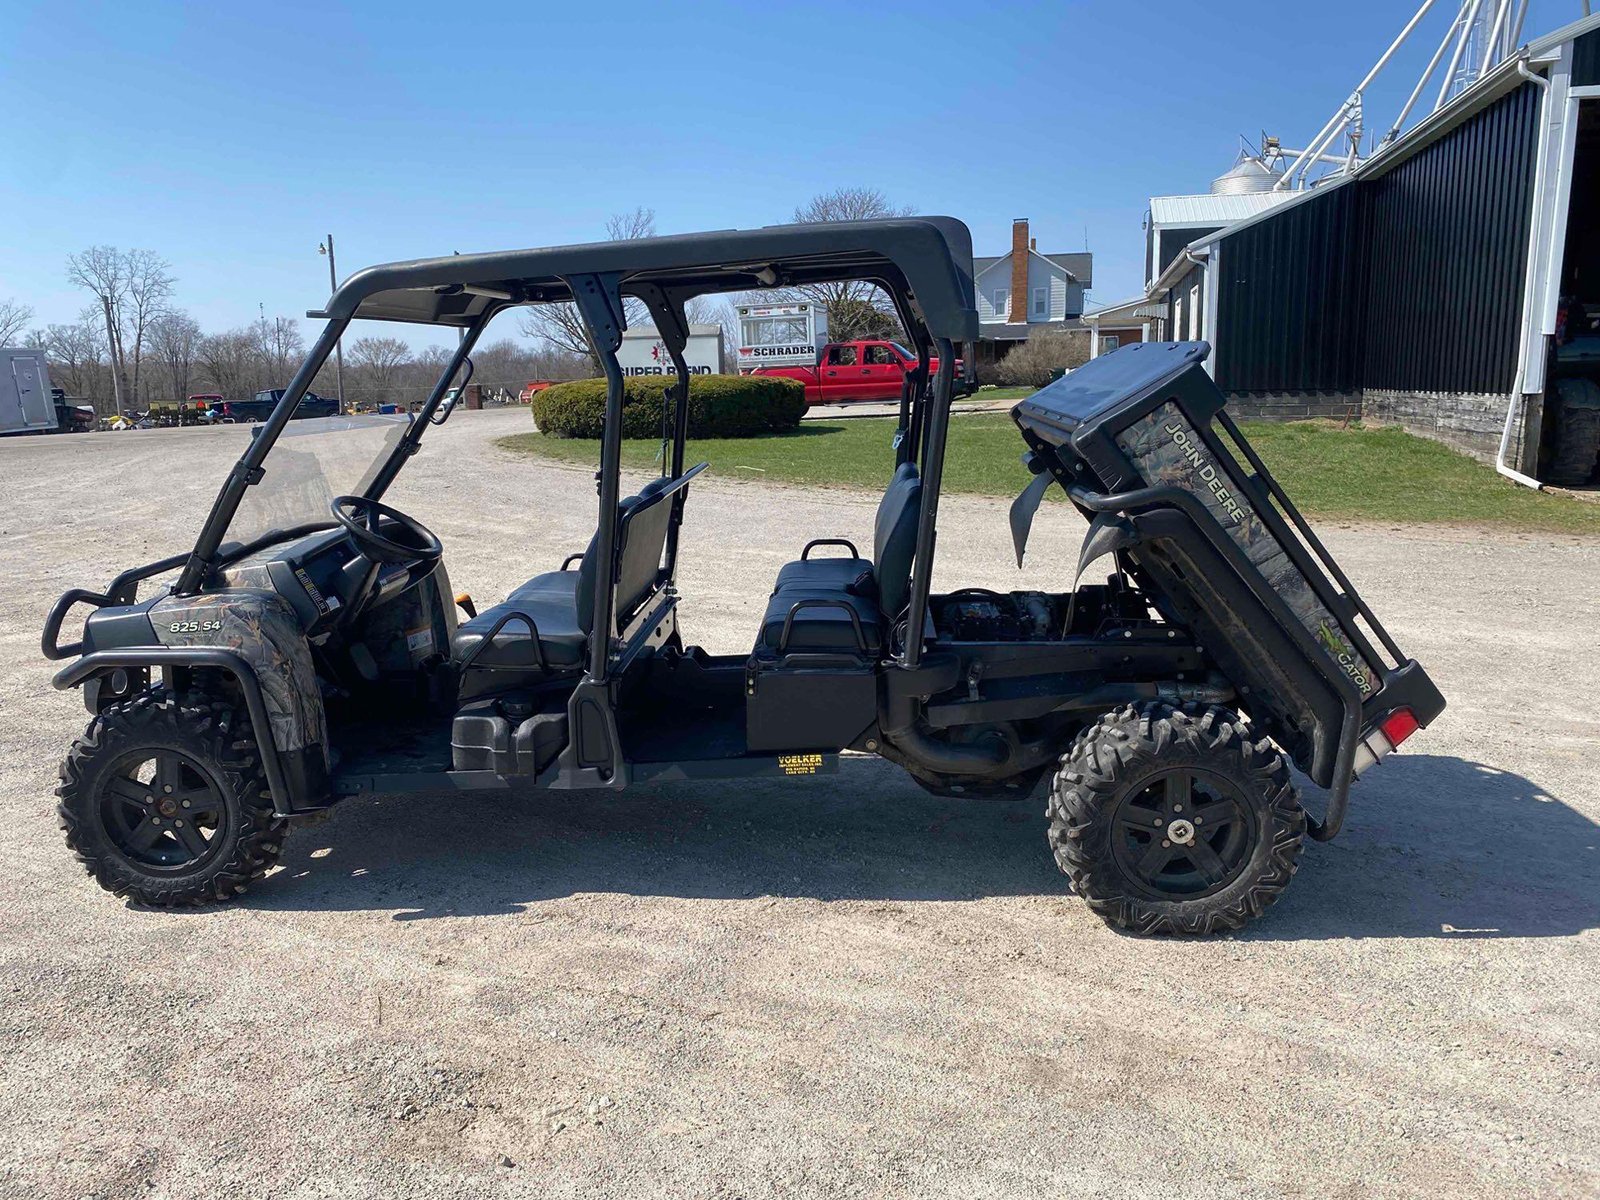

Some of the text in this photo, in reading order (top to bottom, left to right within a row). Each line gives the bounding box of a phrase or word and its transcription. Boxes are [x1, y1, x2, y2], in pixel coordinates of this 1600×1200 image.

[753, 345, 815, 357] SCHRADER
[620, 365, 712, 376] UPER BND
[1164, 422, 1245, 523] JOHN DEERE
[202, 620, 221, 632] S4
[1337, 653, 1371, 693] GATOR
[778, 754, 822, 764] VOELKER
